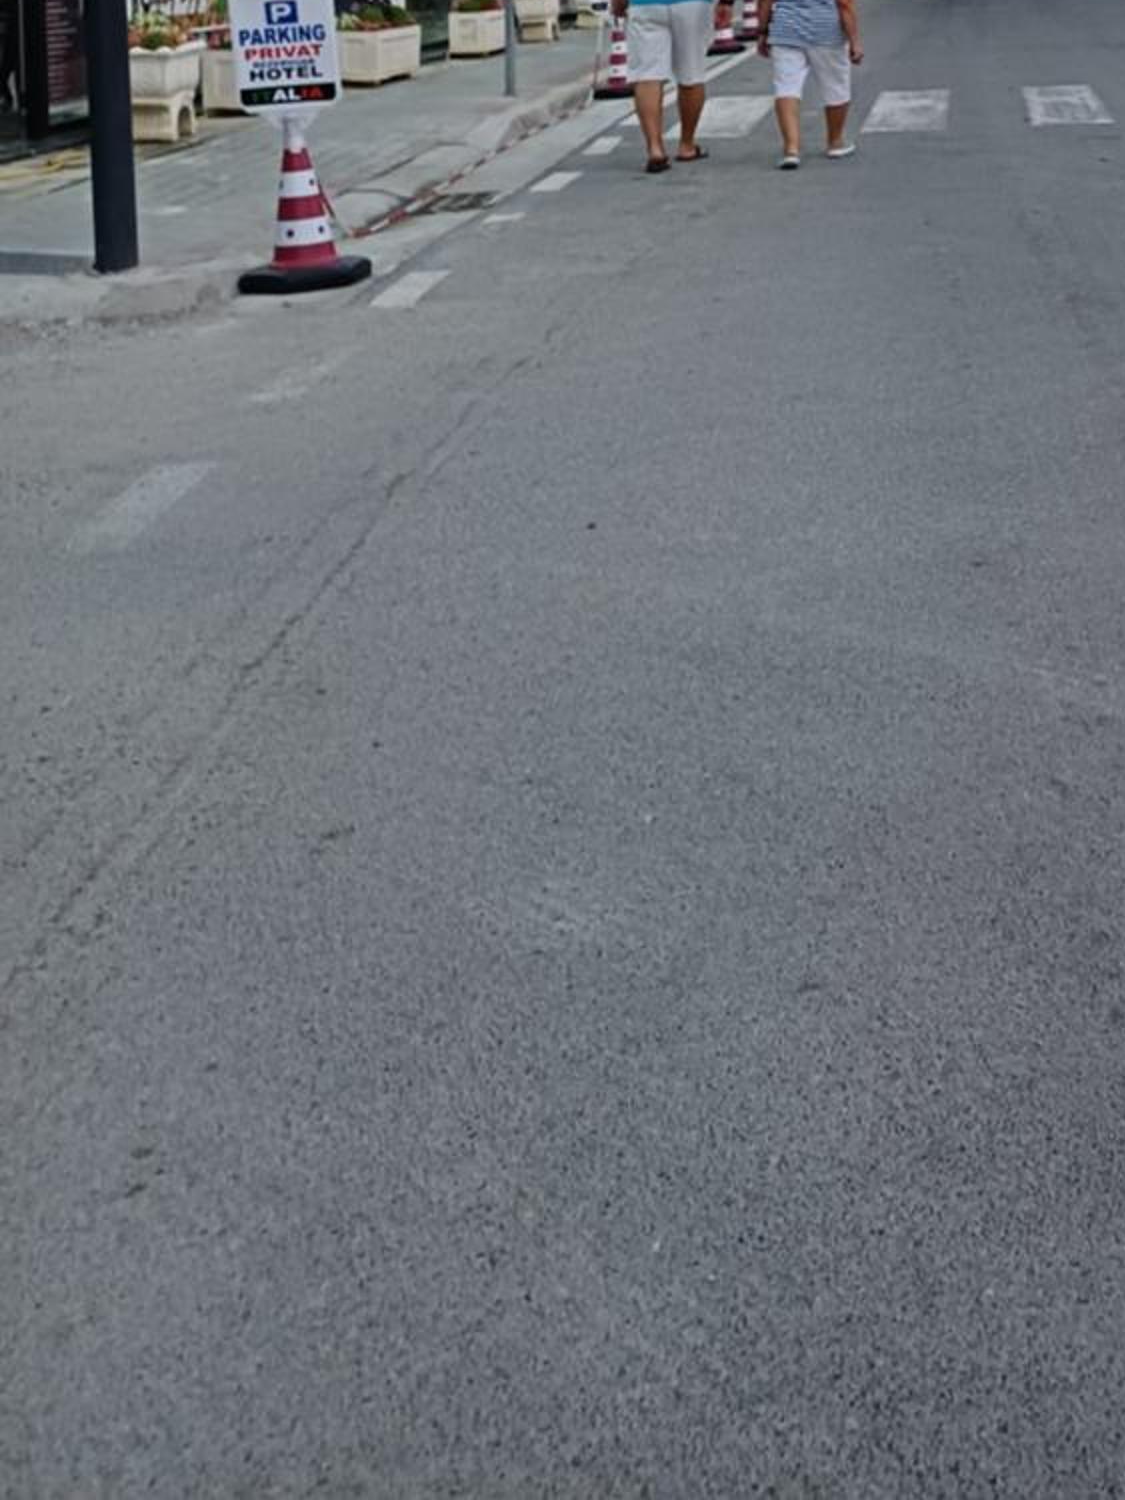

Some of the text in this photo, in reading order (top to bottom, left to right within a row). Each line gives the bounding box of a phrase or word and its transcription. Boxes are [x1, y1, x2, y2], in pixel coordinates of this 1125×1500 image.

[270, 2, 292, 23] P
[238, 24, 326, 46] PARKING
[244, 43, 323, 60] PRIVAT
[249, 65, 323, 81] HOTEL
